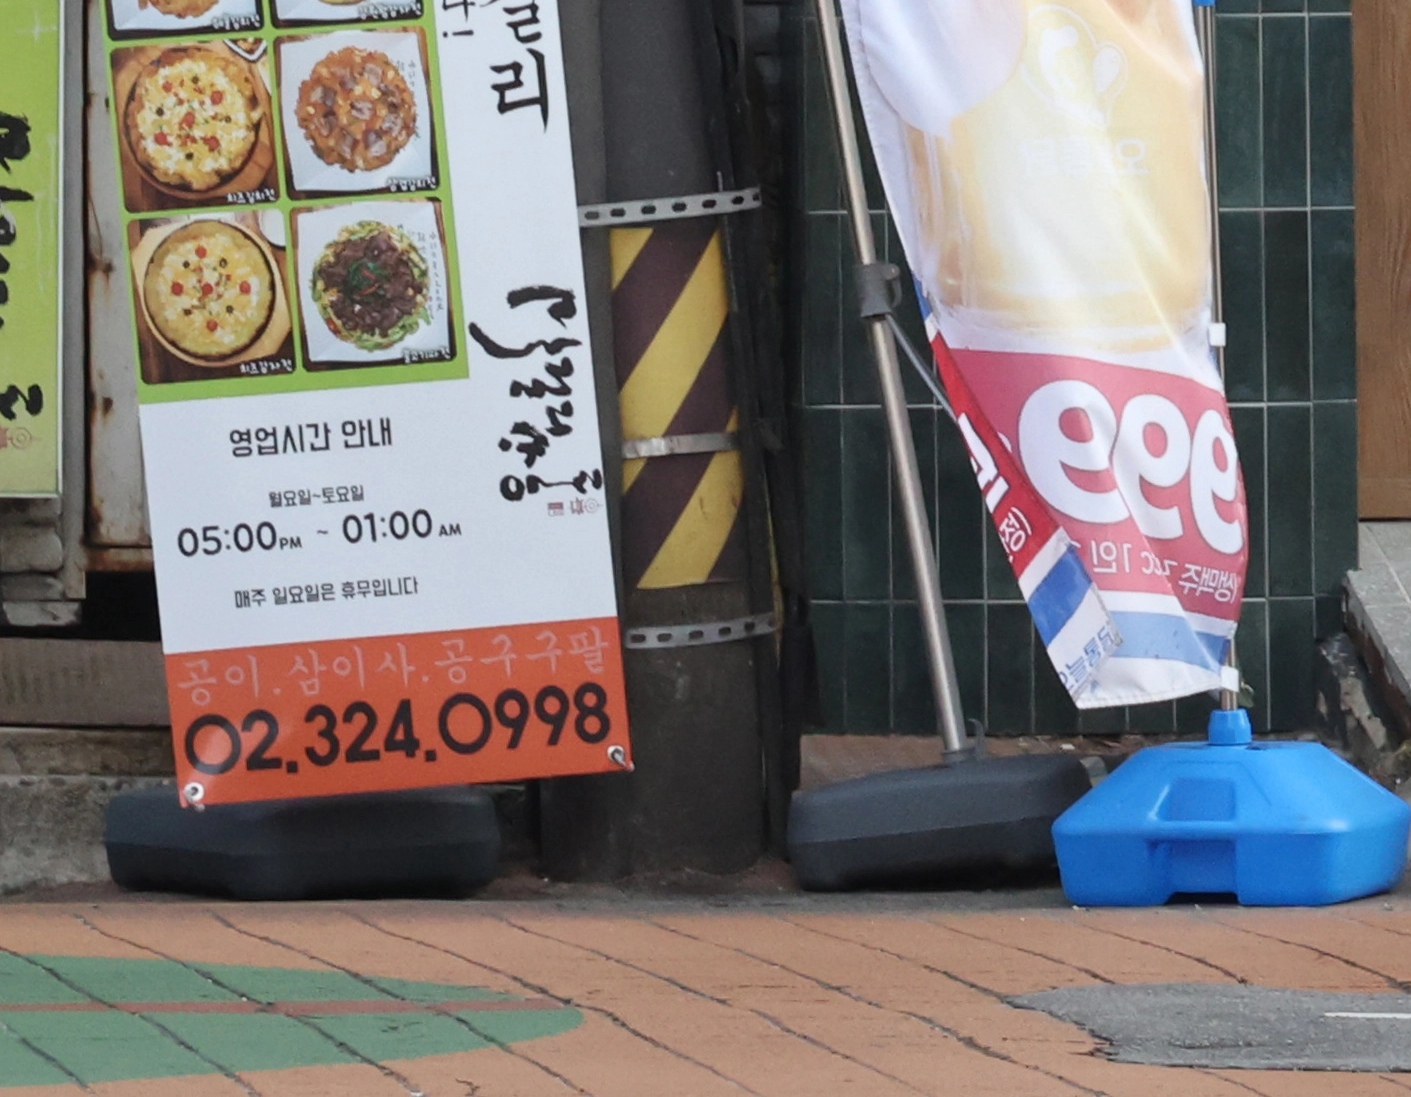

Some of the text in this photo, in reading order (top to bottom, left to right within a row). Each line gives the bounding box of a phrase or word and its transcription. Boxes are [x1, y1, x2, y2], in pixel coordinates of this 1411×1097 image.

[229, 416, 393, 458] 영업시간 안내
[342, 508, 433, 544] 01:00
[234, 576, 419, 609] 매주 일요일은 휴무입니다
[184, 682, 611, 777] 02.324.0998
